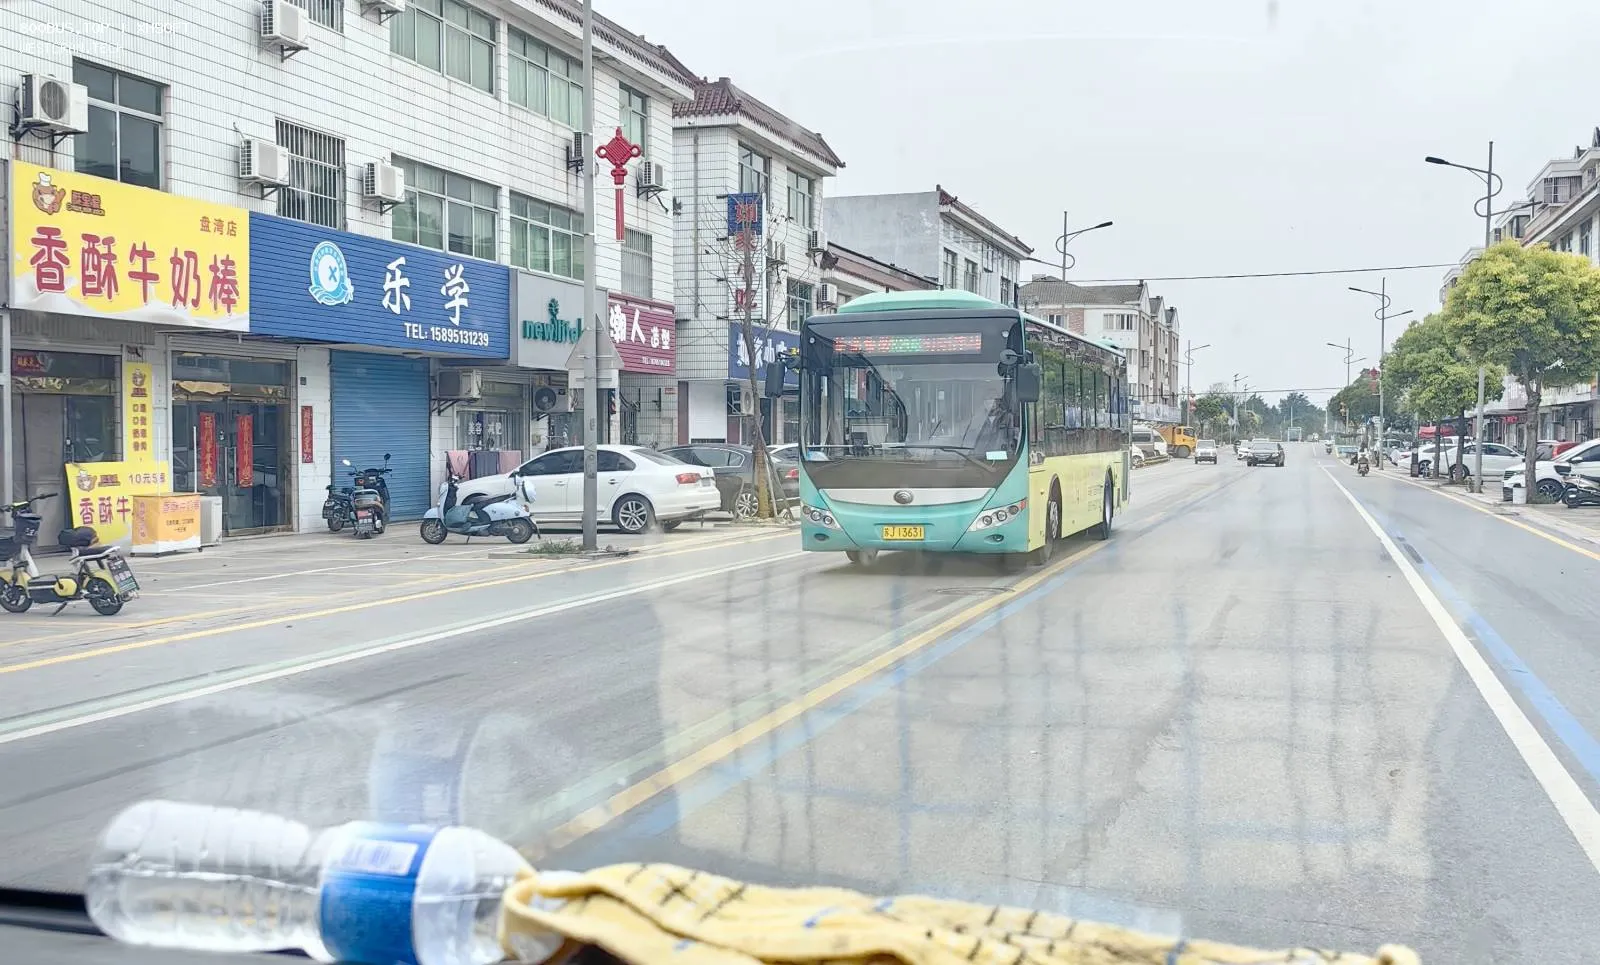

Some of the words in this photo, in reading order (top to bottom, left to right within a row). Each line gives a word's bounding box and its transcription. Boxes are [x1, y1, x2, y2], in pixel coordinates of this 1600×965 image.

[199, 215, 237, 237] 盘湾店
[30, 226, 241, 315] 香酥牛奶棒
[382, 256, 470, 326] 乐学
[404, 322, 428, 341] TEL:
[430, 327, 489, 347] 15895131239
